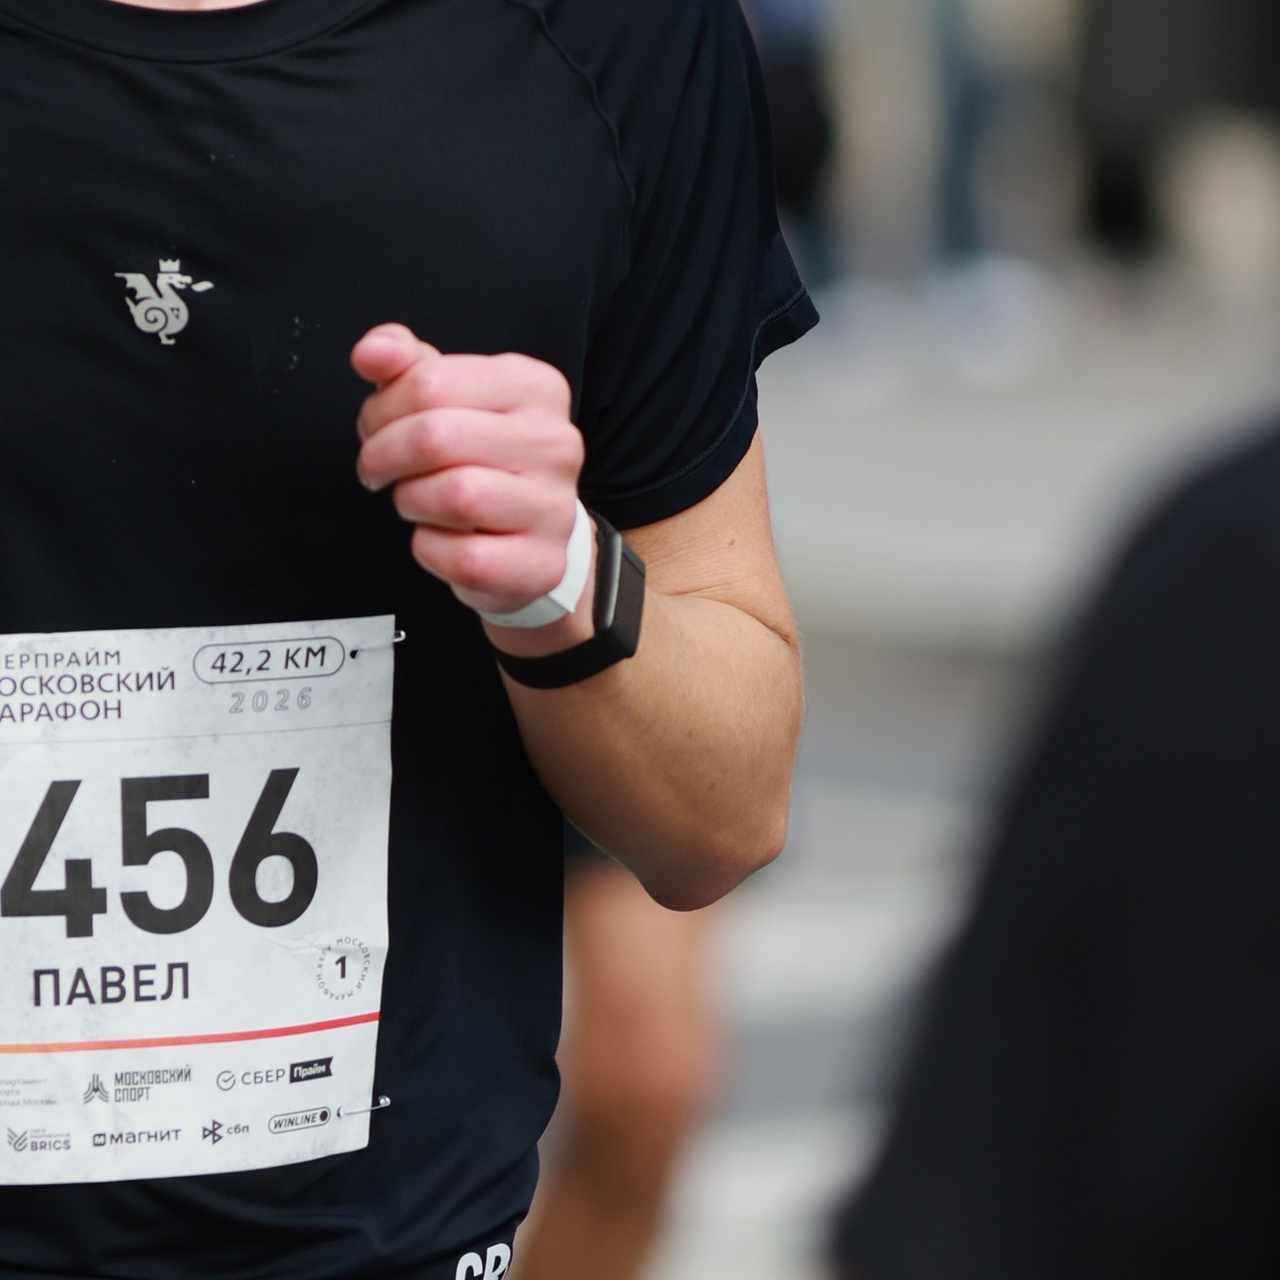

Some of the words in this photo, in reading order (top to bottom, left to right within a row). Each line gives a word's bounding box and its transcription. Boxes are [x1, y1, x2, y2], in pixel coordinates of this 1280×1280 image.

[210, 649, 272, 676] 42,2
[283, 645, 326, 670] КМ
[335, 955, 347, 979] 1
[32, 961, 192, 1007] ПАВЕЛ
[114, 1064, 192, 1086] МОСКОВСКИЙ
[241, 1068, 286, 1085] СБЕР
[293, 1062, 326, 1079] Прайм
[114, 1086, 150, 1103] СПОРТ
[273, 1112, 318, 1130] WINLINE
[29, 1139, 72, 1152] BRICS
[109, 1128, 182, 1145] магнит
